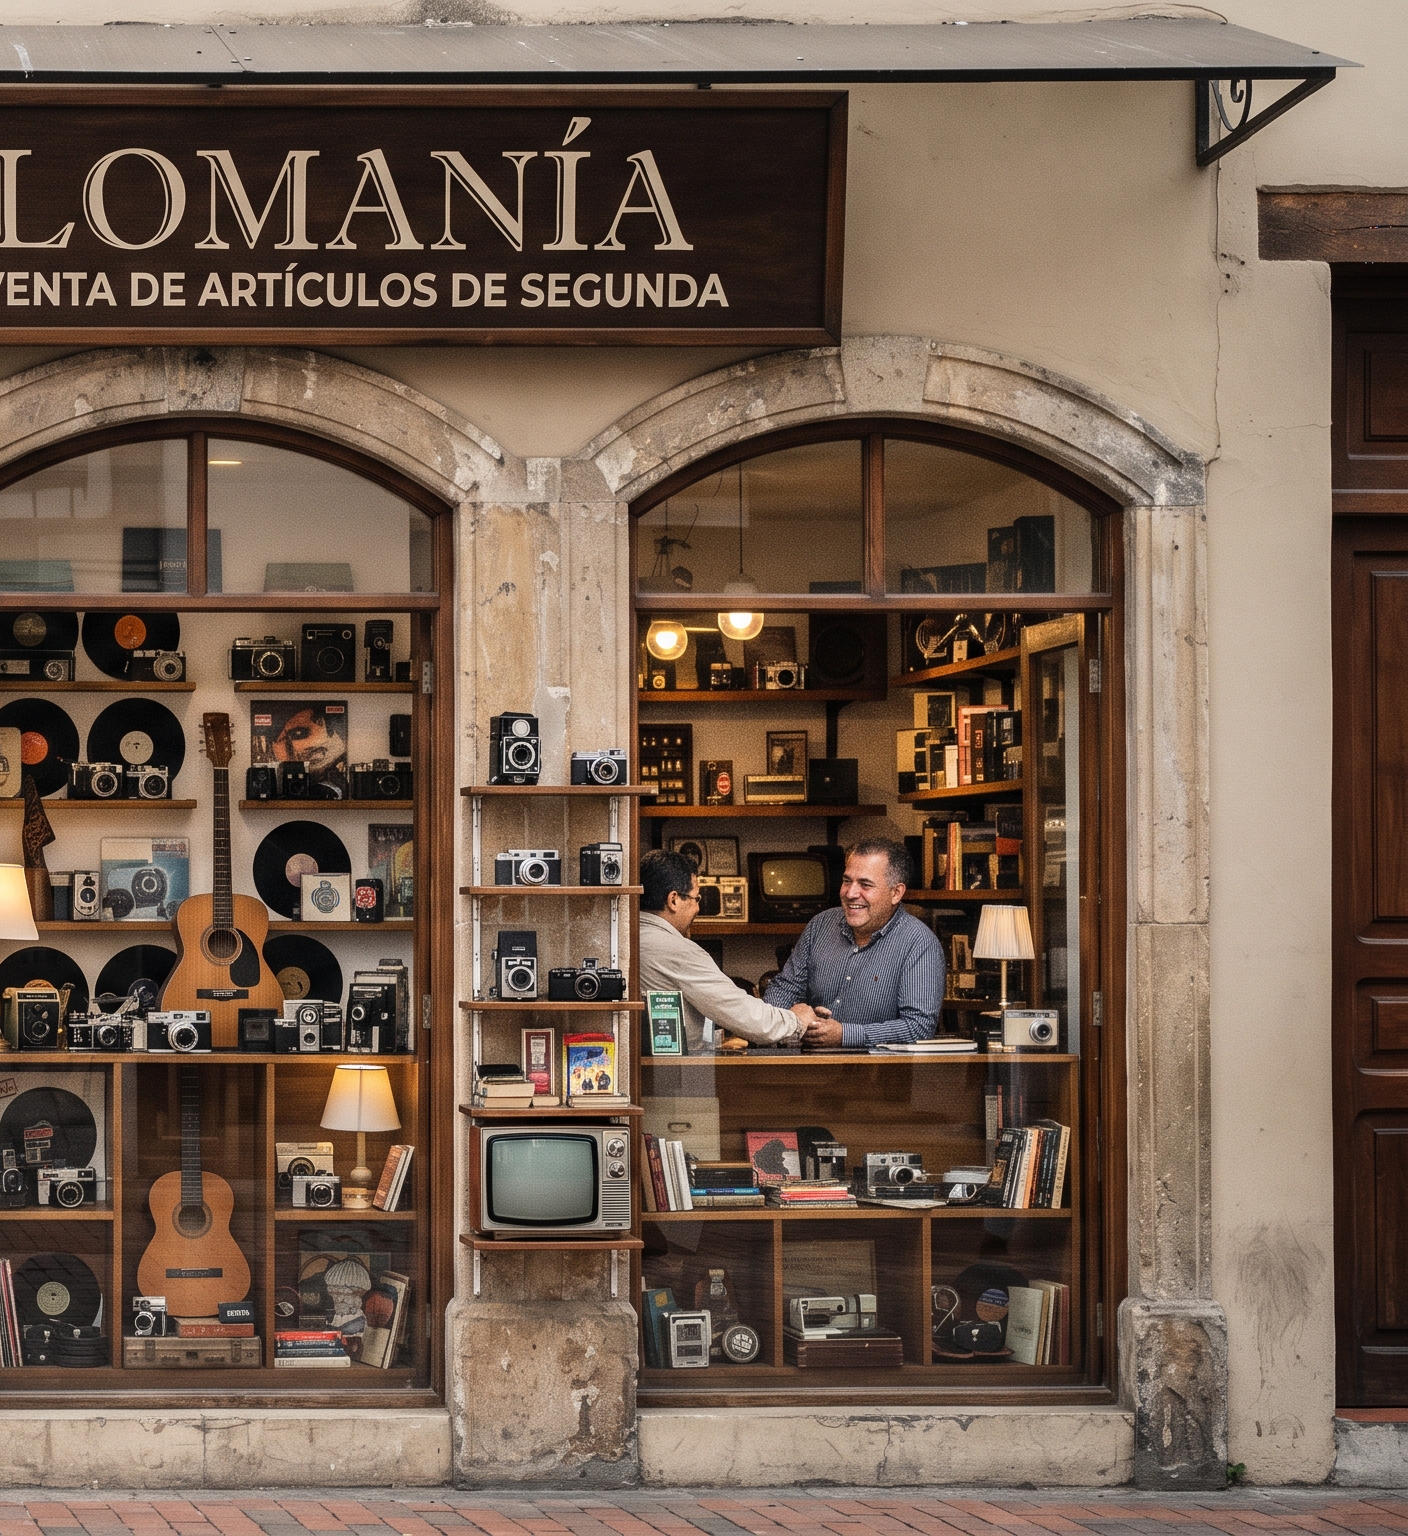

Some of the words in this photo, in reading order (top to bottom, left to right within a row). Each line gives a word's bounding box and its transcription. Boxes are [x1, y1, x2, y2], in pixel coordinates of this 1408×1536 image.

[131, 273, 185, 306] DE
[198, 263, 437, 307] ARTÍCULOS
[453, 273, 506, 307] DE
[521, 273, 728, 307] SEGUNDA
